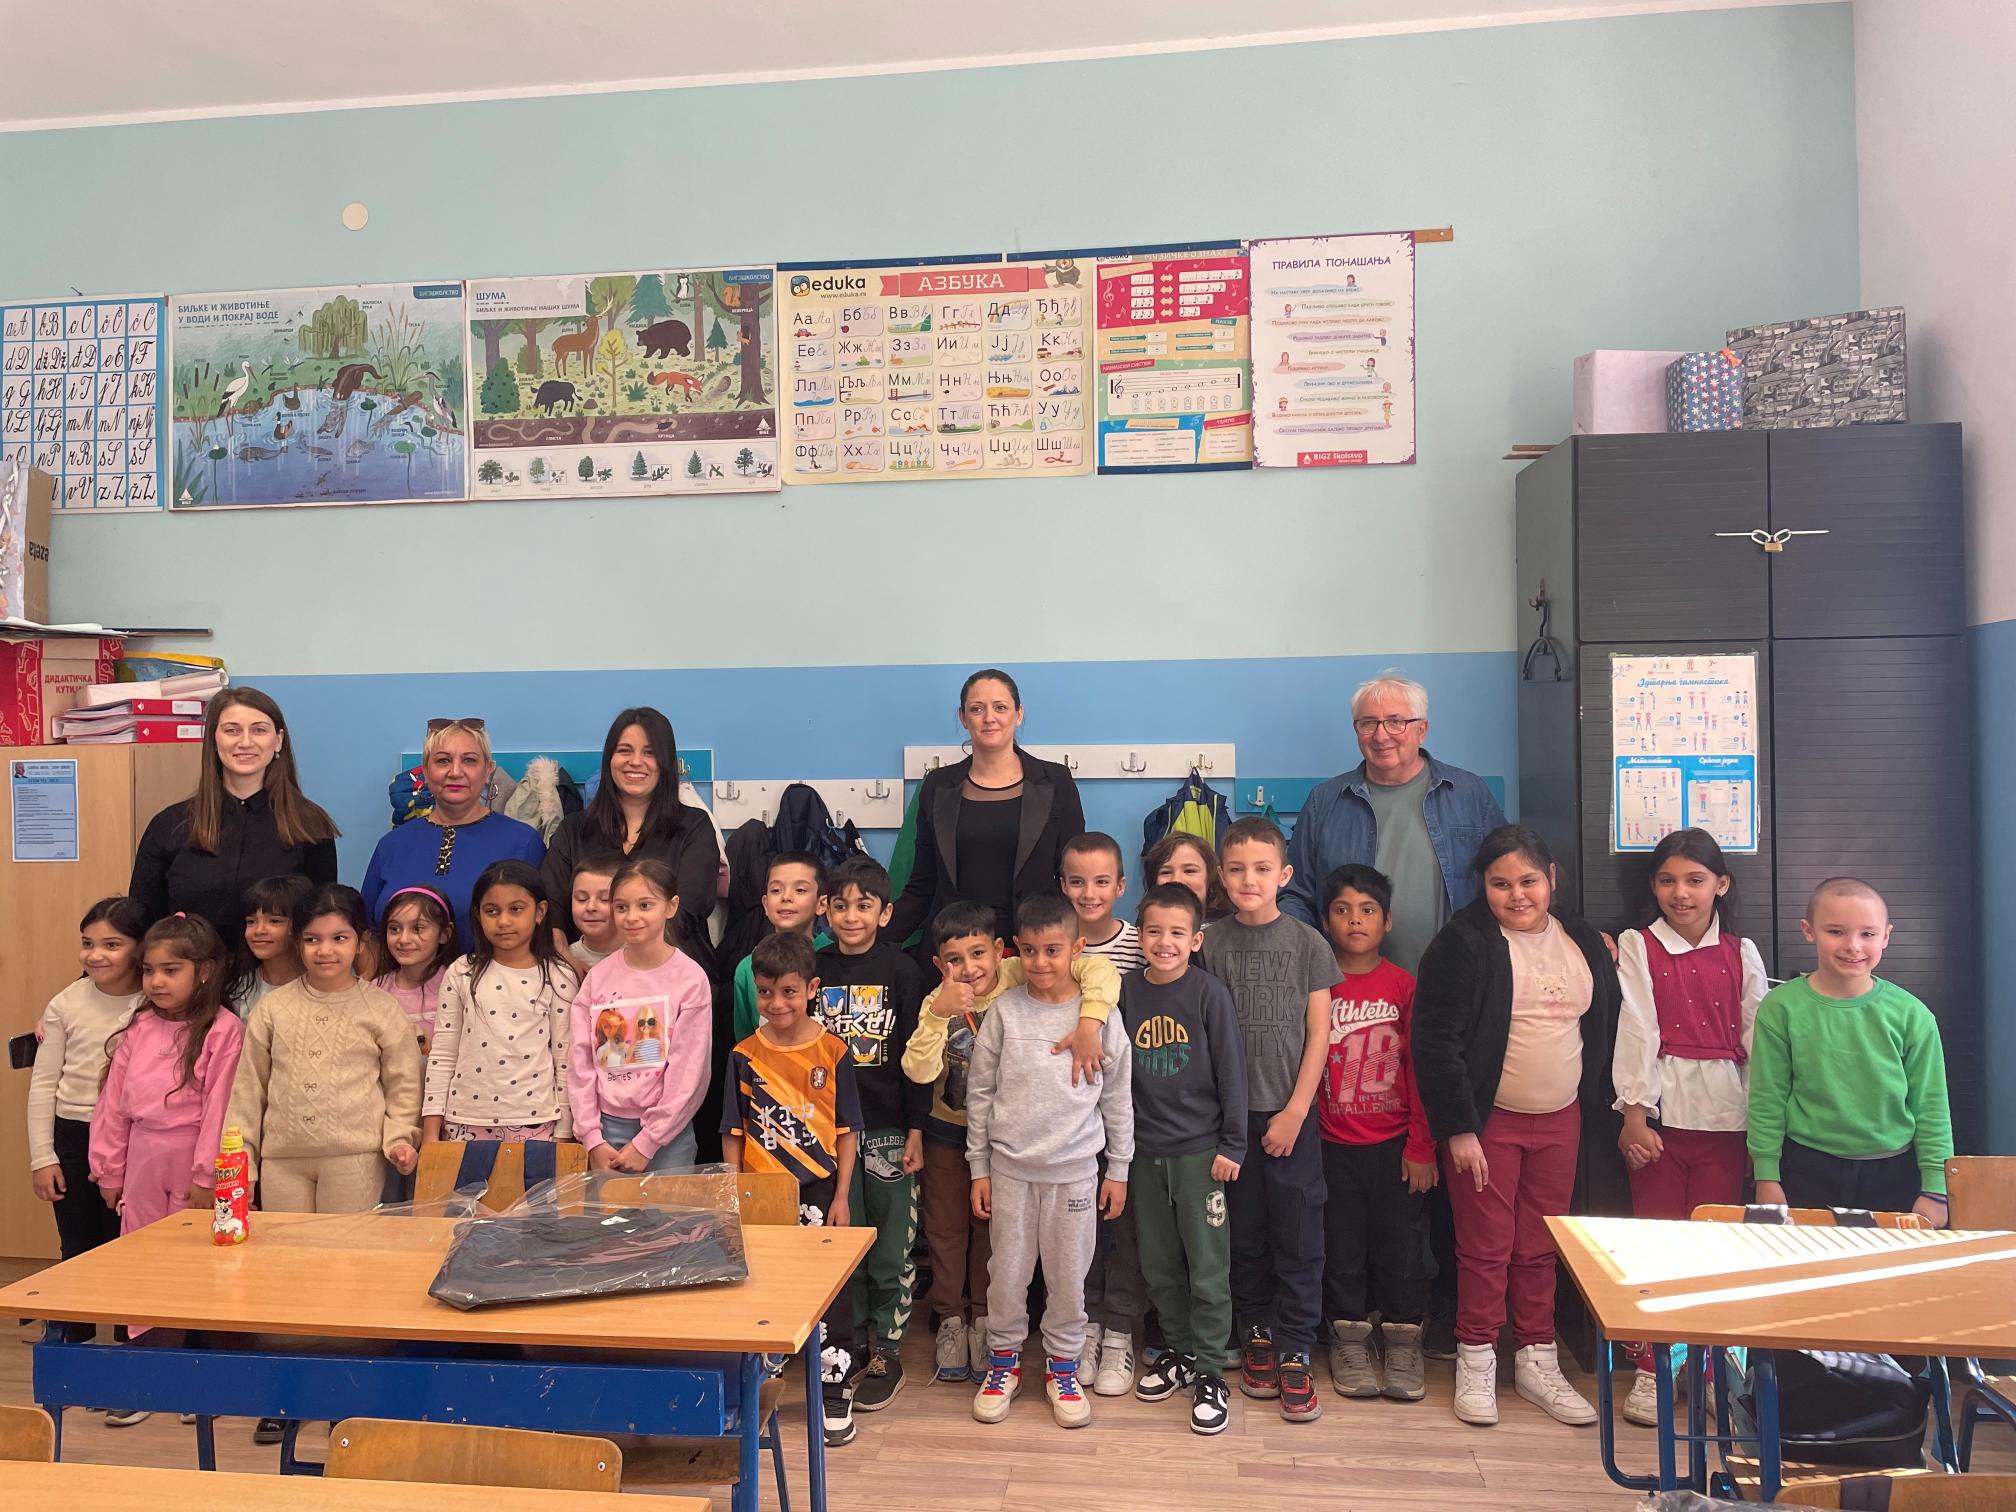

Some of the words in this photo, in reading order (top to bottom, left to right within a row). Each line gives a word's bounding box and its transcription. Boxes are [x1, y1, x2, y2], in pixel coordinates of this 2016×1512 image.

[1272, 260, 1320, 270] ПРАВИЛА
[1326, 256, 1391, 267] ПОНАШАЊА
[812, 276, 866, 290] eduka
[918, 273, 1005, 292] АЗБУКА
[476, 292, 506, 300] ШУМА
[178, 304, 208, 313] БИЉКЕ
[220, 301, 270, 310] ЖИВОТИЊЕ
[186, 316, 210, 324] ВОДИ
[222, 314, 254, 322] ПОКРАЈ
[256, 312, 279, 320] ВОДЕ
[1333, 452, 1363, 460] školstvo
[44, 674, 92, 684] ДИДАКТИЧКА
[1224, 950, 1292, 982] NEW
[1232, 984, 1296, 1022] ORK
[1135, 1016, 1188, 1048] GOOD
[1240, 1024, 1290, 1058] ITY
[1136, 1044, 1192, 1078] TIMES
[1339, 1025, 1400, 1103] 18
[866, 1136, 906, 1150] COLLEGE
[1206, 1190, 1226, 1227] 9
